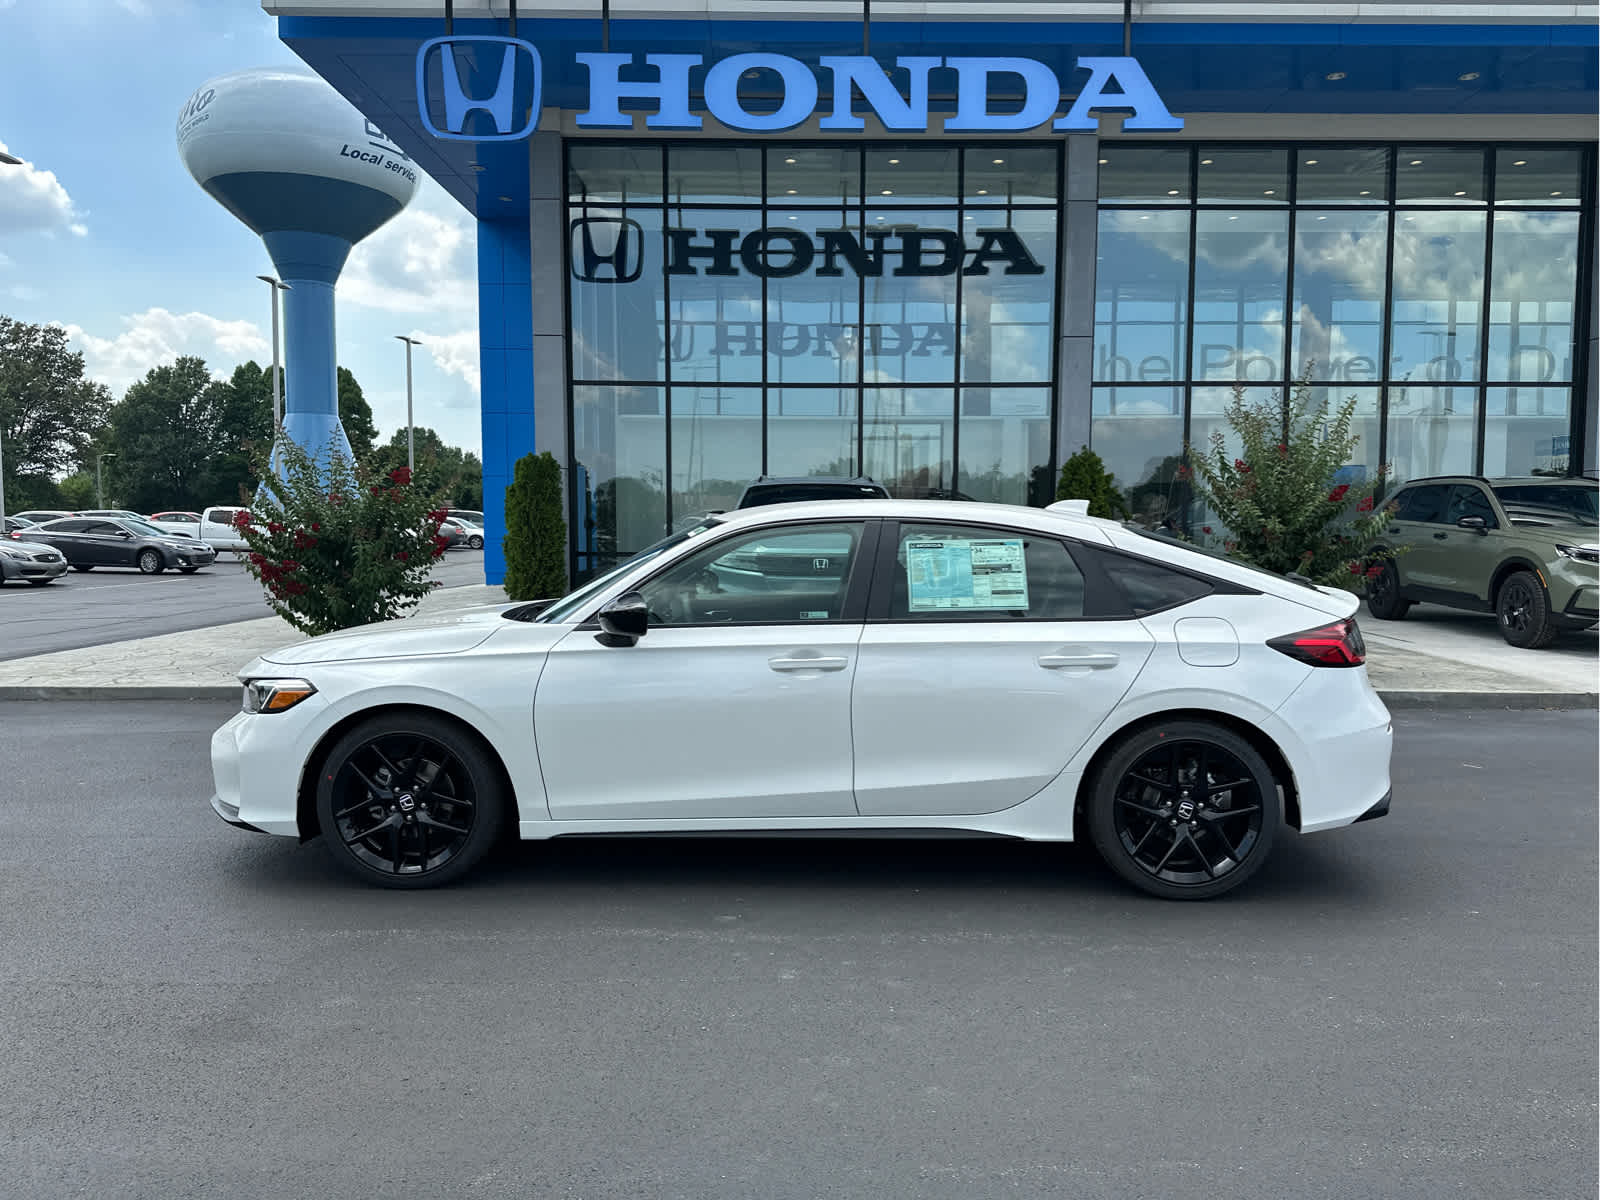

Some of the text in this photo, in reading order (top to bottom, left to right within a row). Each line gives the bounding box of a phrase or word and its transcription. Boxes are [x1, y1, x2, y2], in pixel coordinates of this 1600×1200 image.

[576, 52, 1184, 133] HONDA
[340, 144, 384, 166] Local
[664, 227, 1045, 278] HONDA
